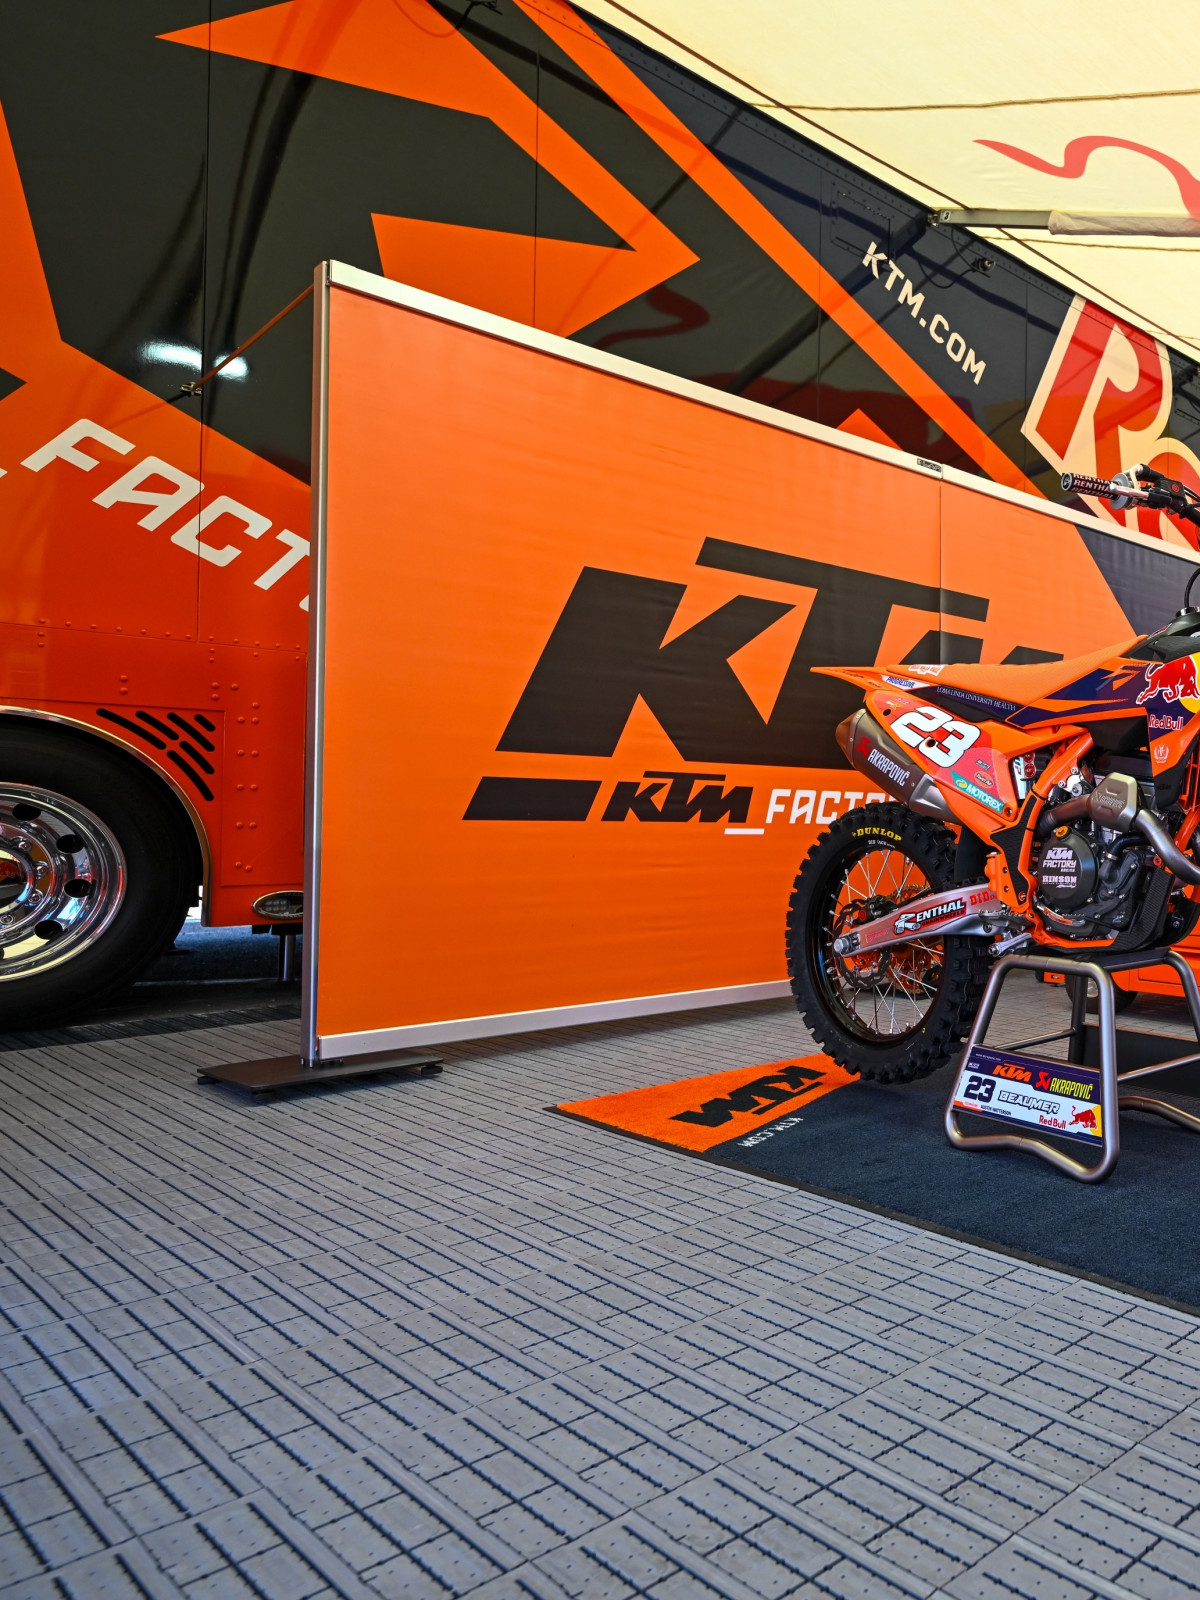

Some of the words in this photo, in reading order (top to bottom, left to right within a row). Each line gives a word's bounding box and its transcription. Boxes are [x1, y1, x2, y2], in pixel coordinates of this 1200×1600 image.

[862, 241, 987, 386] KTM.COM
[1073, 479, 1111, 493] RENTHA
[20, 418, 311, 612] FACT
[937, 686, 951, 696] LOMA
[951, 689, 965, 699] LINDA
[966, 692, 994, 708] UNIVERSITY
[994, 700, 1017, 712] HEALTH
[1148, 714, 1165, 728] Red
[1165, 715, 1184, 731] Bull
[889, 705, 982, 769] 23
[600, 770, 754, 823] KTM
[765, 788, 897, 824] FACT
[966, 783, 1003, 812] MOTOREX
[857, 827, 902, 841] DUNLOP
[1042, 860, 1077, 868] FACTORY
[1046, 847, 1073, 859] KTM
[1042, 875, 1077, 883] HINSON
[969, 891, 990, 906] DID
[992, 1063, 1033, 1083] KTM
[669, 1065, 827, 1128] KTM
[963, 1075, 997, 1103] 23
[997, 1090, 1061, 1115] BEAUMER
[1039, 1115, 1053, 1126] Red
[1053, 1118, 1067, 1129] Bull
